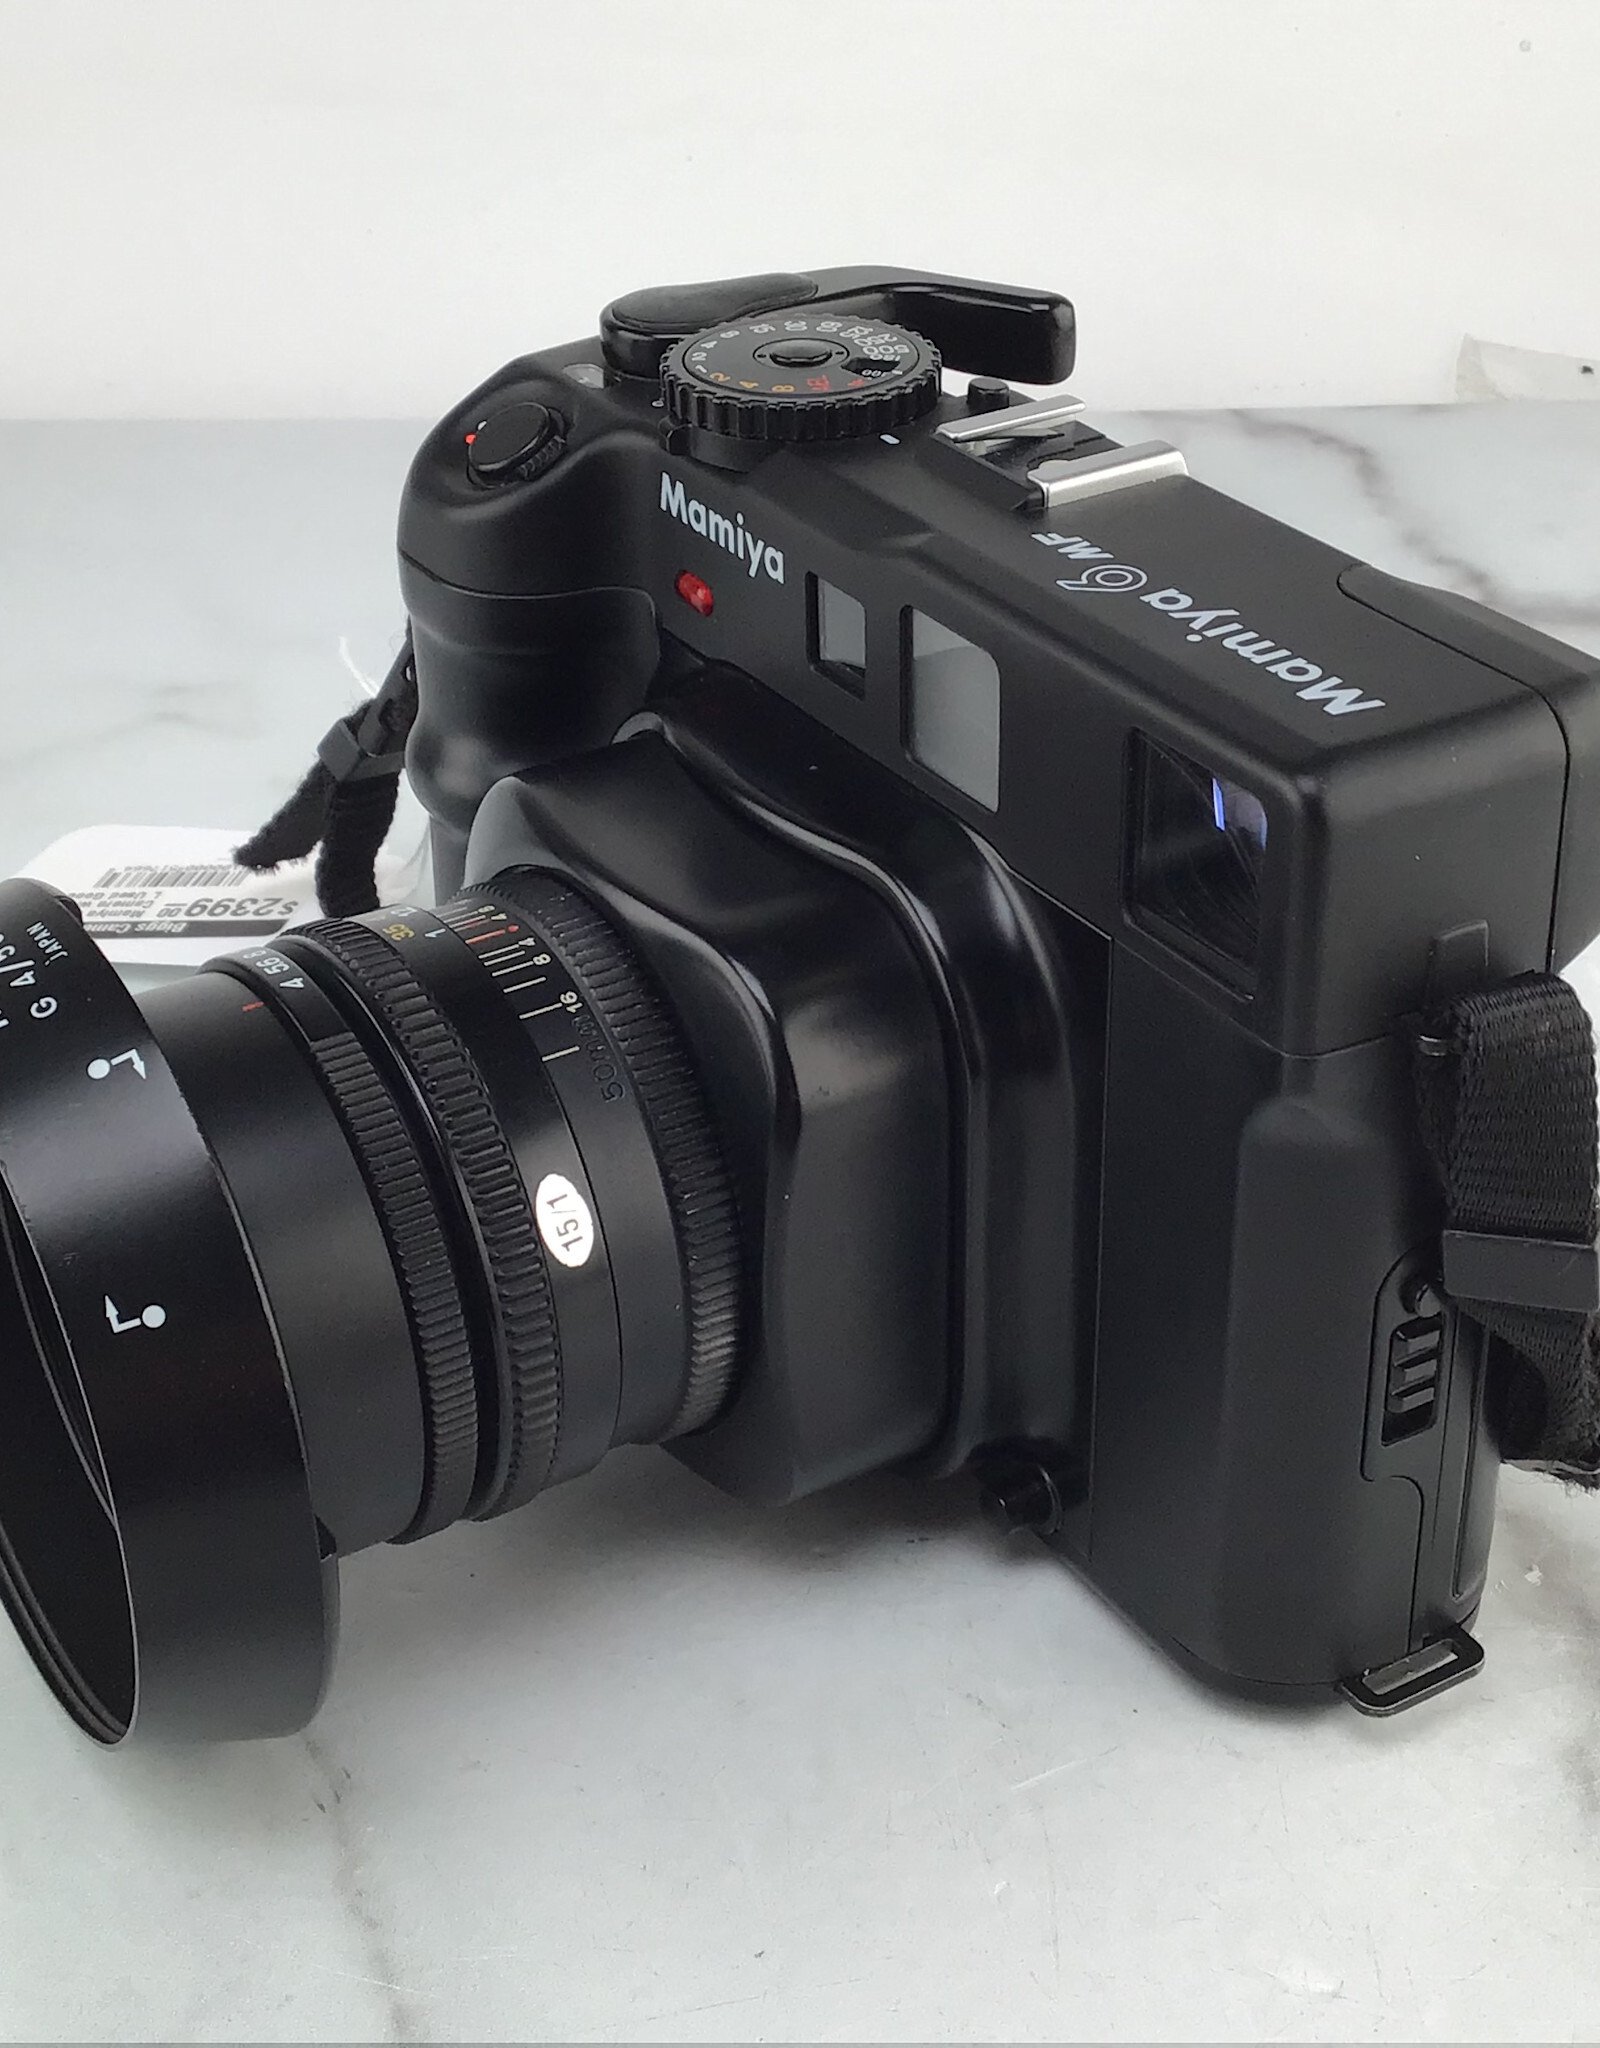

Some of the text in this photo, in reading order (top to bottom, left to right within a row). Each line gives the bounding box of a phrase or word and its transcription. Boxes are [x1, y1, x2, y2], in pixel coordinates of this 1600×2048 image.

[784, 320, 808, 332] 30
[659, 471, 785, 585] Mamiya
[1031, 531, 1387, 716] Mamiya 6 MF
[183, 897, 299, 918] $2399
[134, 920, 188, 934] Biggs
[279, 977, 305, 989] 4
[532, 953, 552, 966] 8
[560, 991, 584, 1014] 16
[30, 996, 58, 1019] G
[546, 1193, 584, 1253] 15/1
